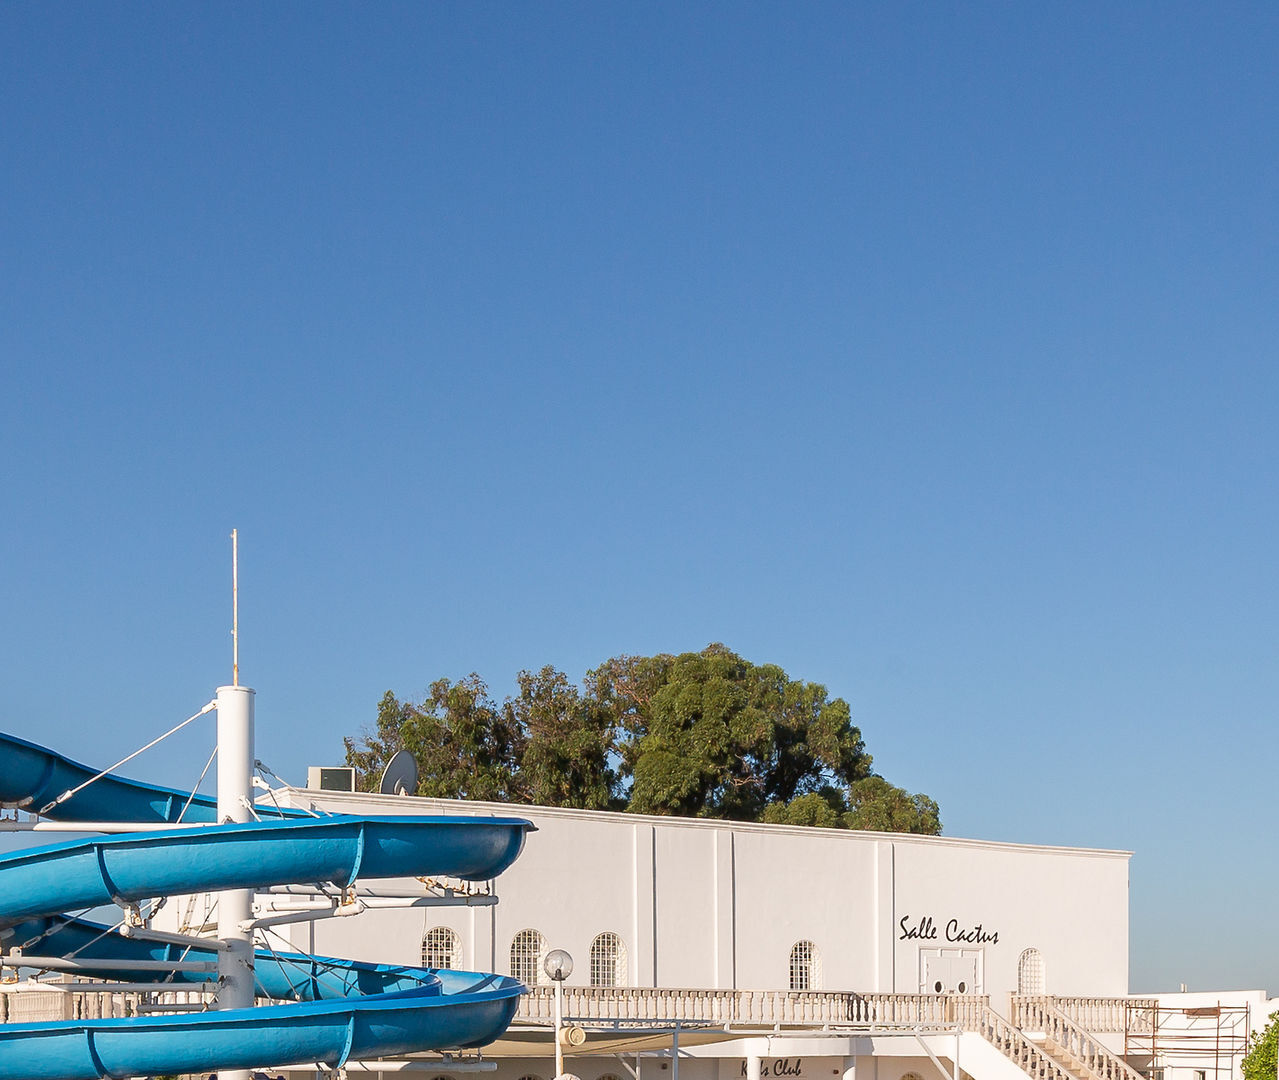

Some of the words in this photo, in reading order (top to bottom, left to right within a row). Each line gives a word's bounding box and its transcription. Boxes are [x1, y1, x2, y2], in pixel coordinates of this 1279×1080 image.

[899, 915, 937, 940] Salle
[945, 918, 999, 945] Cactus
[740, 1059, 769, 1077] Ks
[773, 1058, 802, 1077] Club
